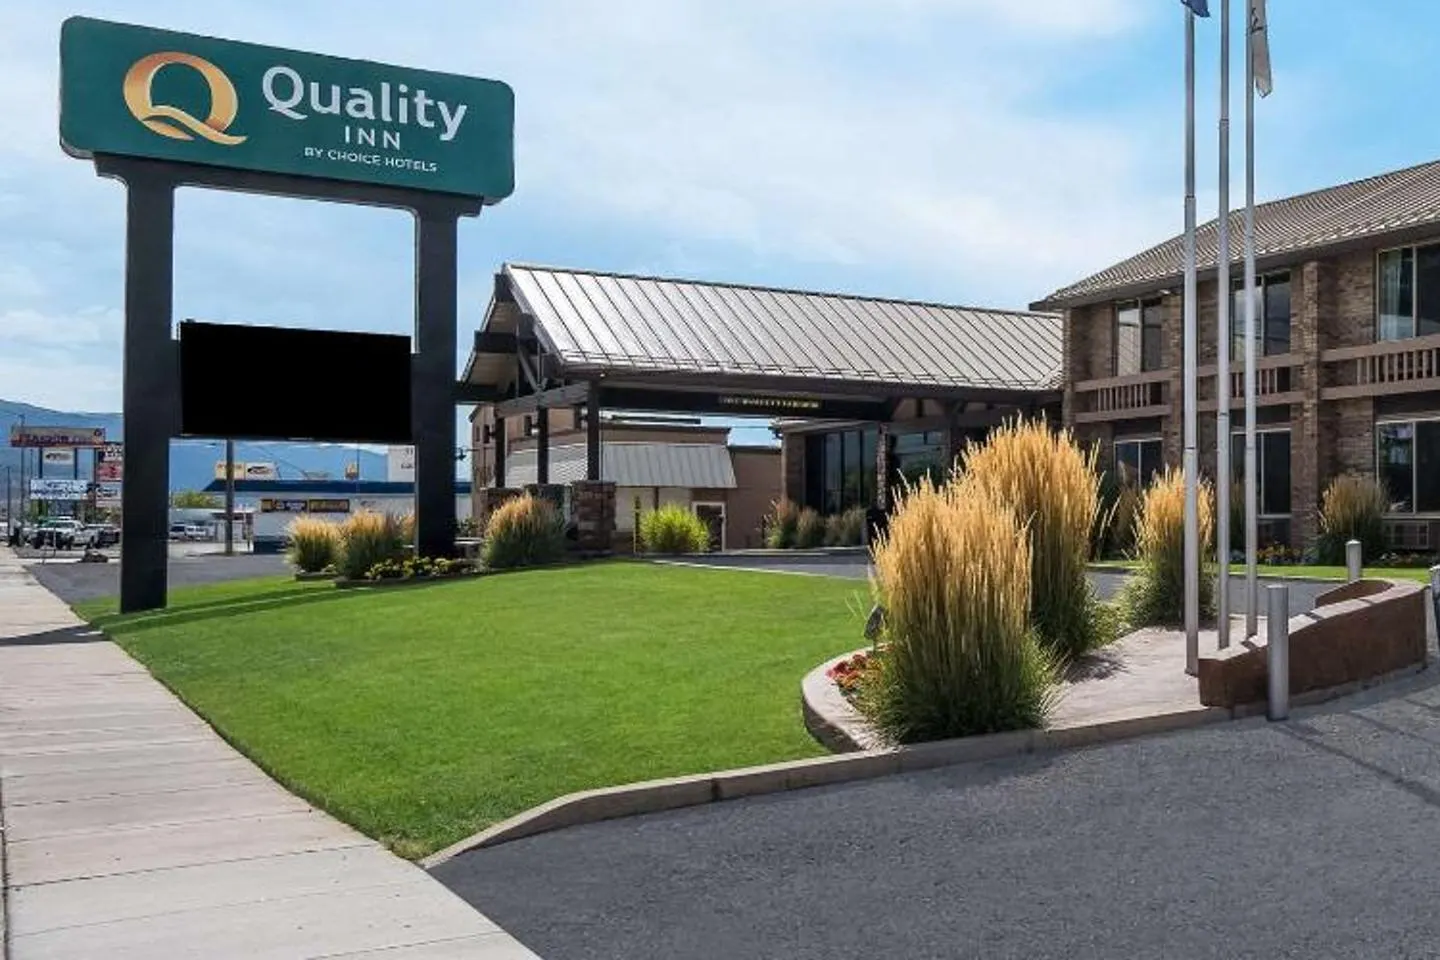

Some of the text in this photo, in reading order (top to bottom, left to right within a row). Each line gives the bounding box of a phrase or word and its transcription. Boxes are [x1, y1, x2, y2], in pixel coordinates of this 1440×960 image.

[262, 66, 467, 141] Quality
[345, 126, 400, 150] INN
[304, 147, 437, 172] BY CHOICE HOTELS
